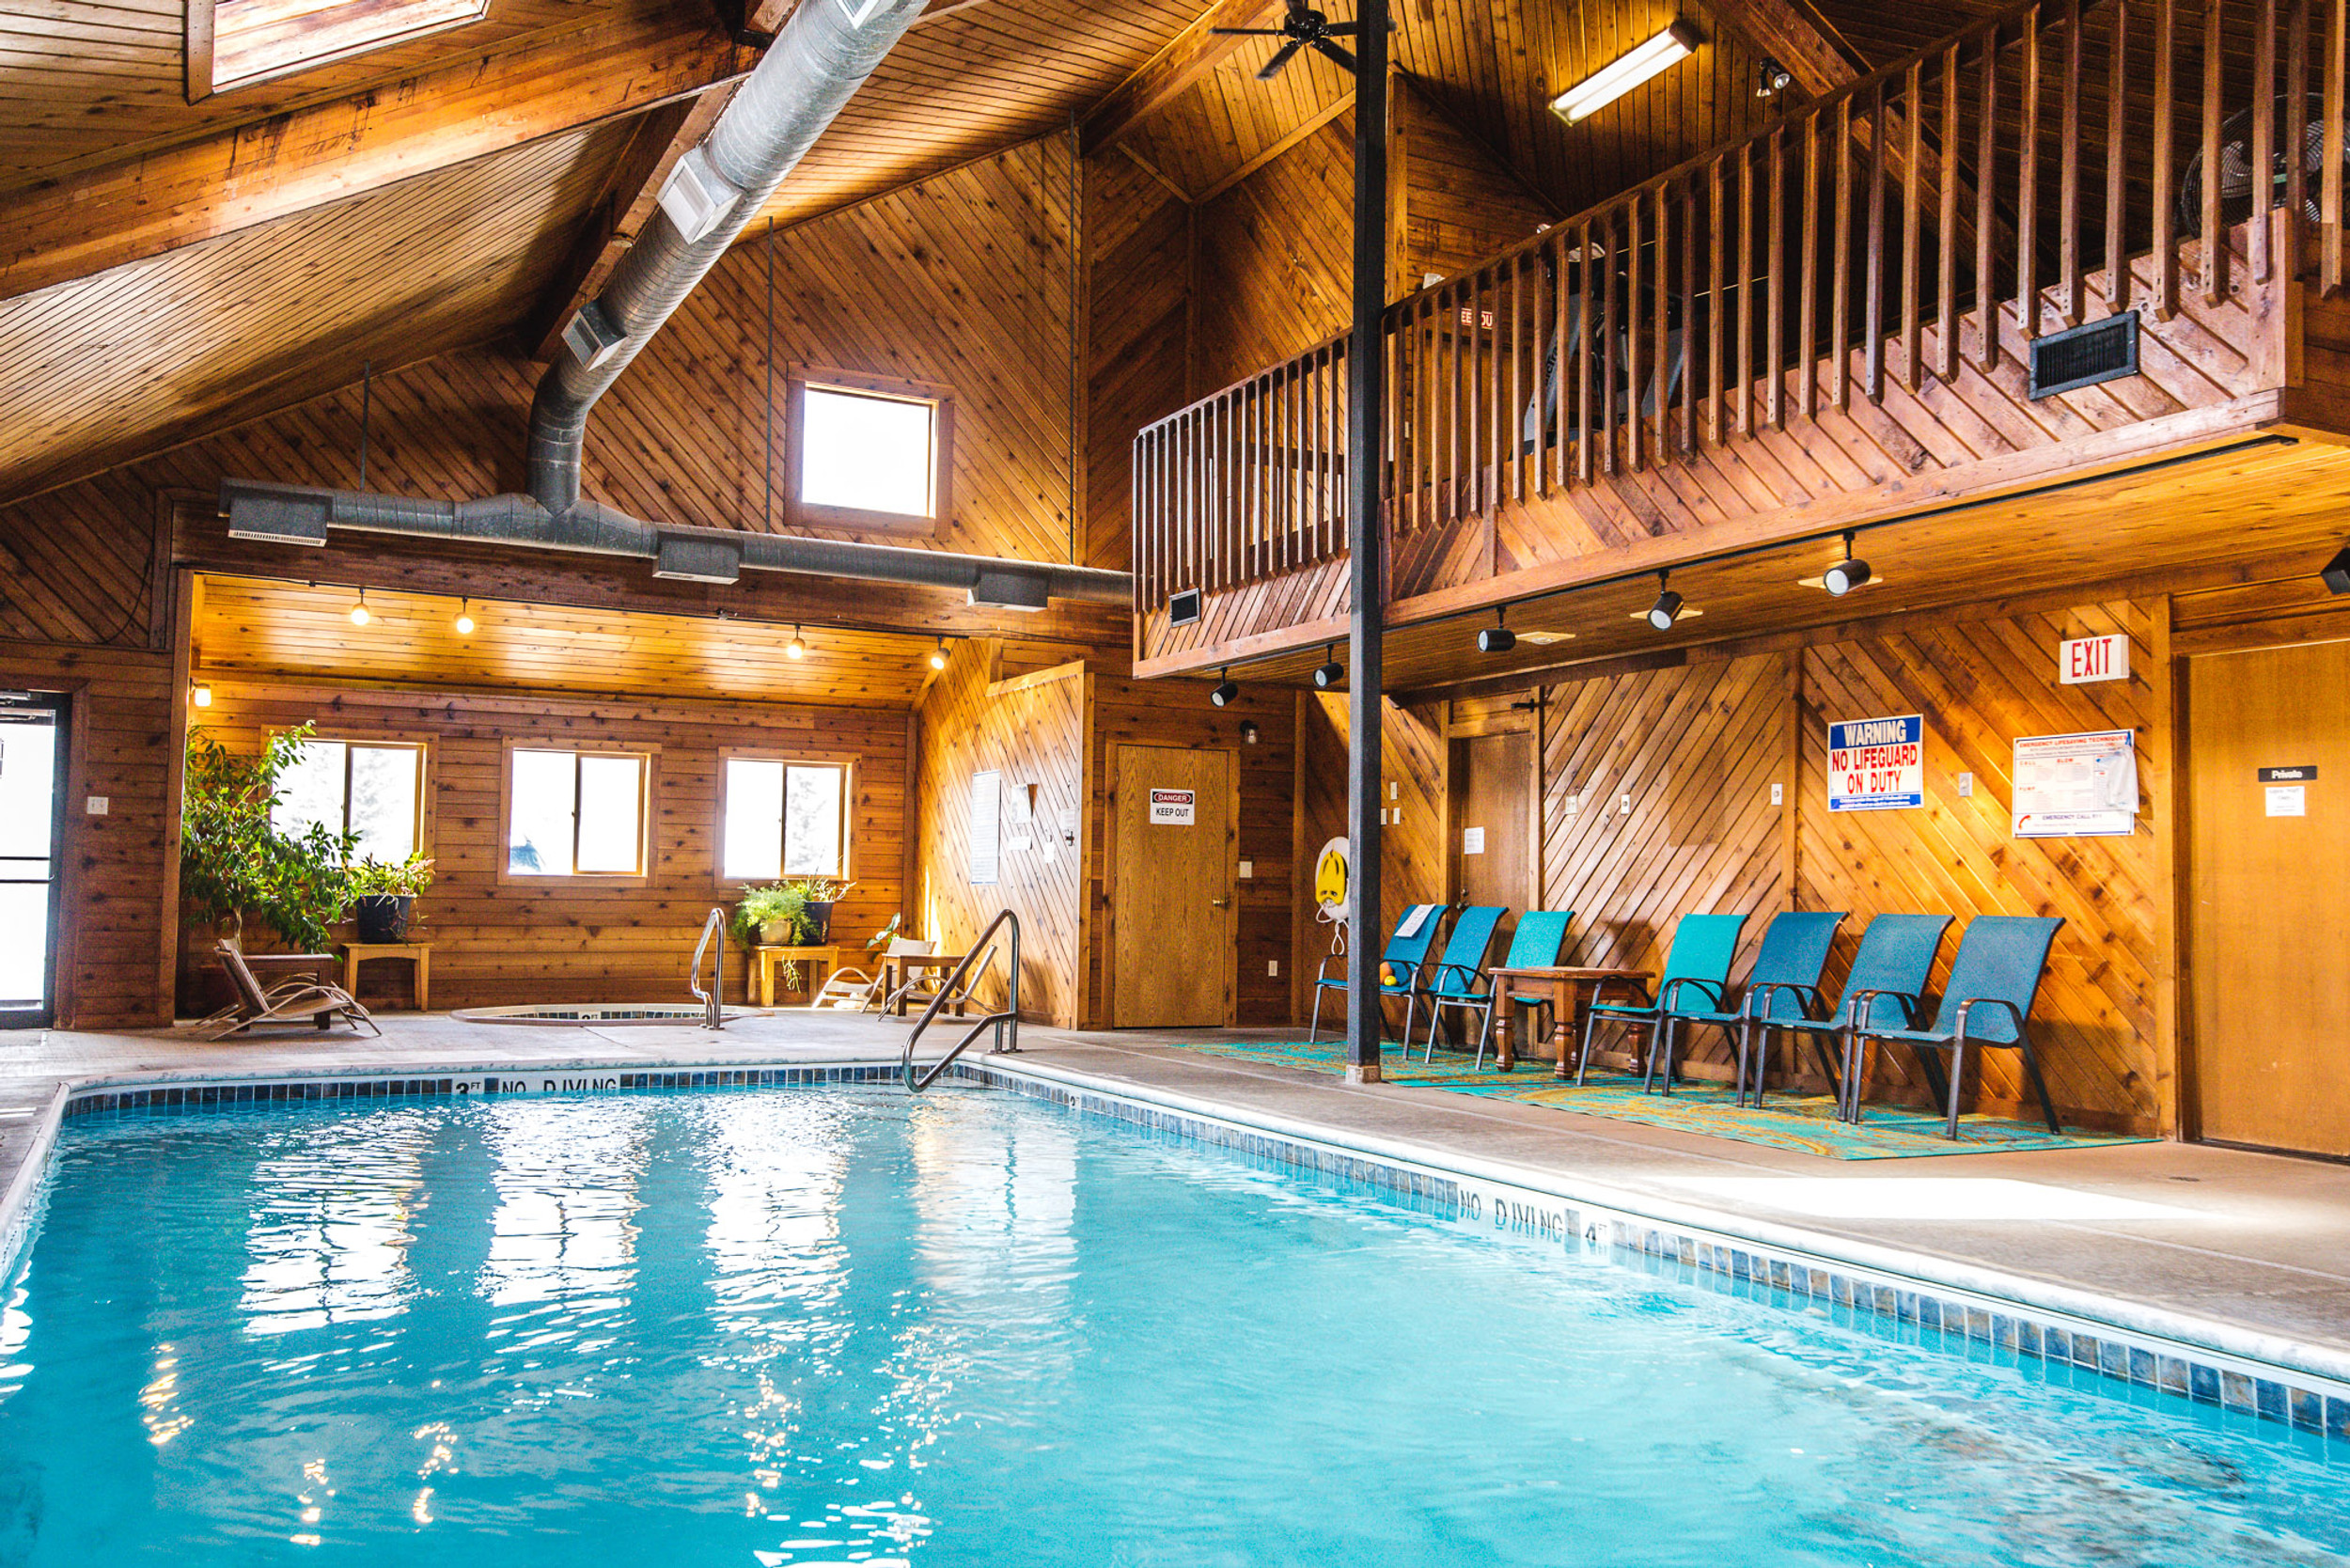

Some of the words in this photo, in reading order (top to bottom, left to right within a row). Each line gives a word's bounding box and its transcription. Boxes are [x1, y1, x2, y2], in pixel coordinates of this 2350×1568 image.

[1461, 310, 1472, 324] EE
[2072, 637, 2112, 678] EXIT
[1843, 719, 1907, 746] WARNING
[2019, 739, 2053, 748] EMERGENCY
[2055, 737, 2087, 746] LIFESAVING
[1832, 750, 1848, 772] NO
[1854, 744, 1918, 770] LIFEGUARD
[2271, 769, 2303, 779] Private
[1847, 773, 1863, 794] ON
[1871, 770, 1902, 793] DUTY
[1157, 793, 1187, 802] DANGER
[1155, 808, 1173, 816] KEEP
[1175, 808, 1189, 817] OUT
[502, 1080, 526, 1093] NO
[543, 1078, 617, 1092] DIVING
[1460, 1189, 1481, 1211] NO
[1495, 1197, 1563, 1231] DIVING
